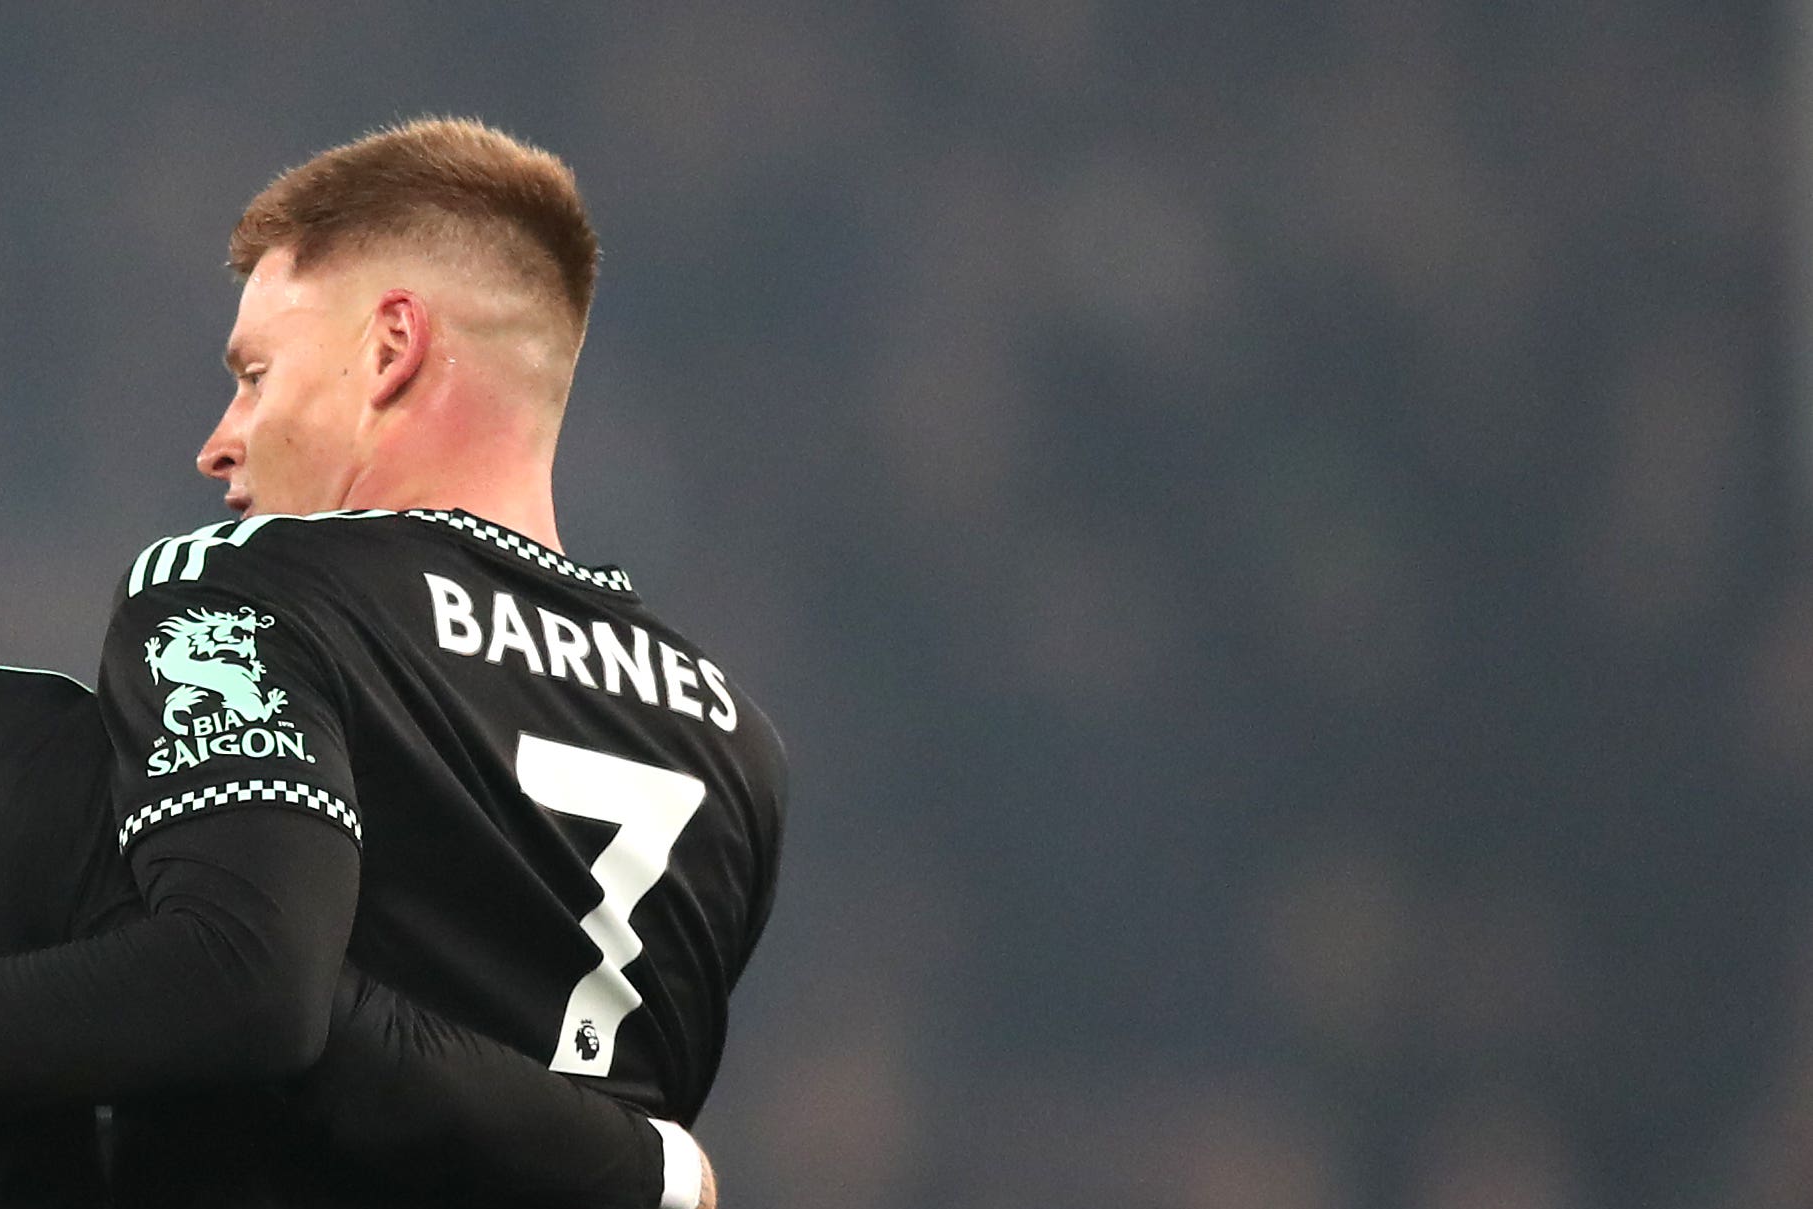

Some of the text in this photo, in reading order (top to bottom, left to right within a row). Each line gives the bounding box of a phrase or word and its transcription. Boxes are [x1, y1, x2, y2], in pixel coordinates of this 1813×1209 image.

[193, 709, 244, 736] BIA
[424, 572, 738, 732] BARNES
[516, 734, 706, 1077] 7
